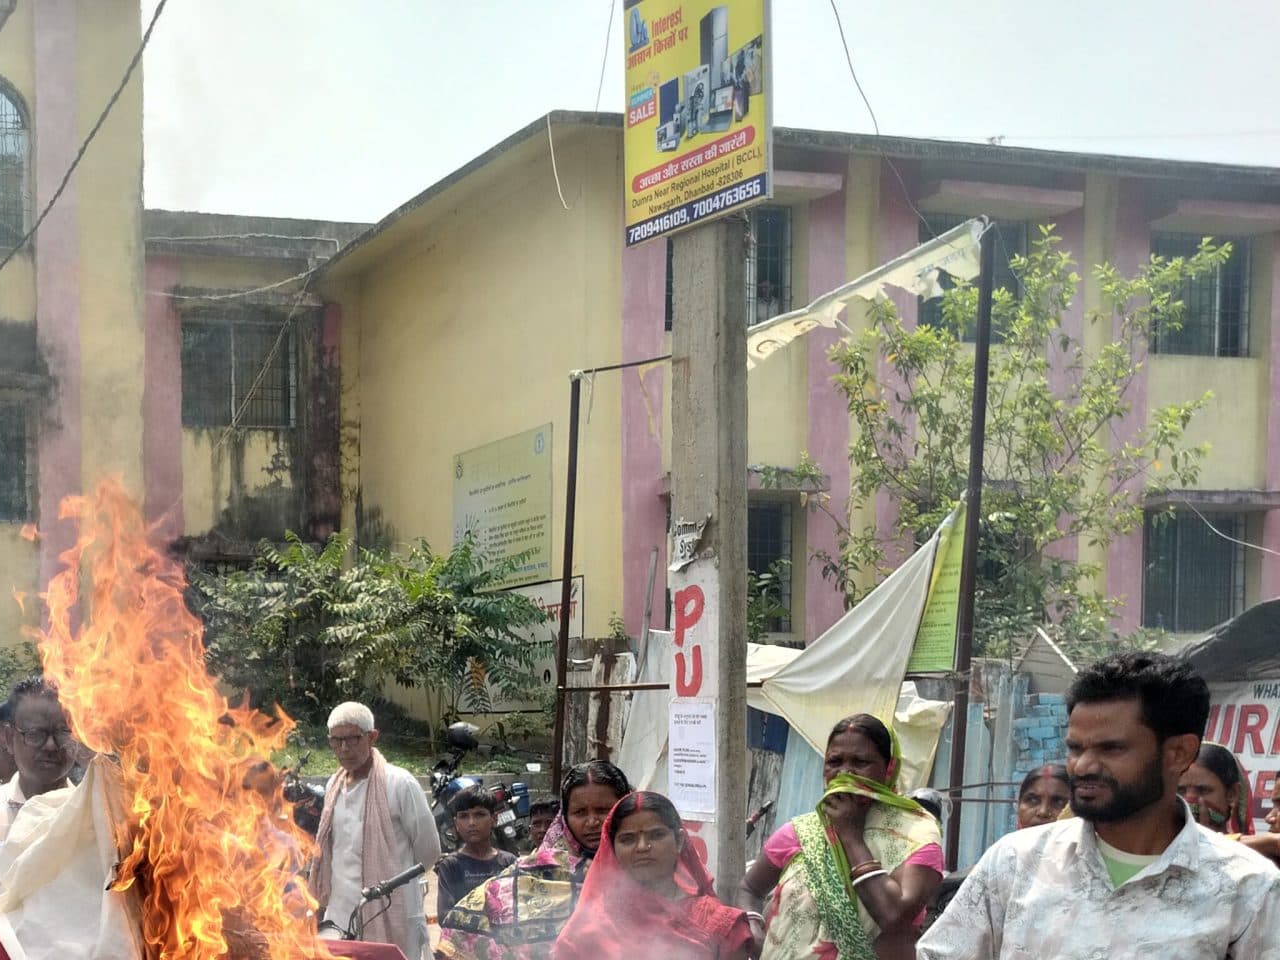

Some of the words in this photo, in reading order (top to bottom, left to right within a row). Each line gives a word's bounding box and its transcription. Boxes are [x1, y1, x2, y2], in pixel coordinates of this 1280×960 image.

[652, 6, 682, 38] Interest
[630, 101, 655, 124] SALE
[663, 161, 679, 181] और
[681, 154, 703, 172] सस्ता
[704, 145, 718, 161] की
[720, 131, 746, 154] गारंटी
[632, 194, 652, 209] Dumra
[654, 187, 669, 199] Near
[671, 174, 700, 193] Regional
[701, 162, 730, 182] Hospital
[684, 181, 715, 201] Dhanbad
[629, 209, 690, 244] 7209416109,
[693, 179, 761, 218] 7004763656
